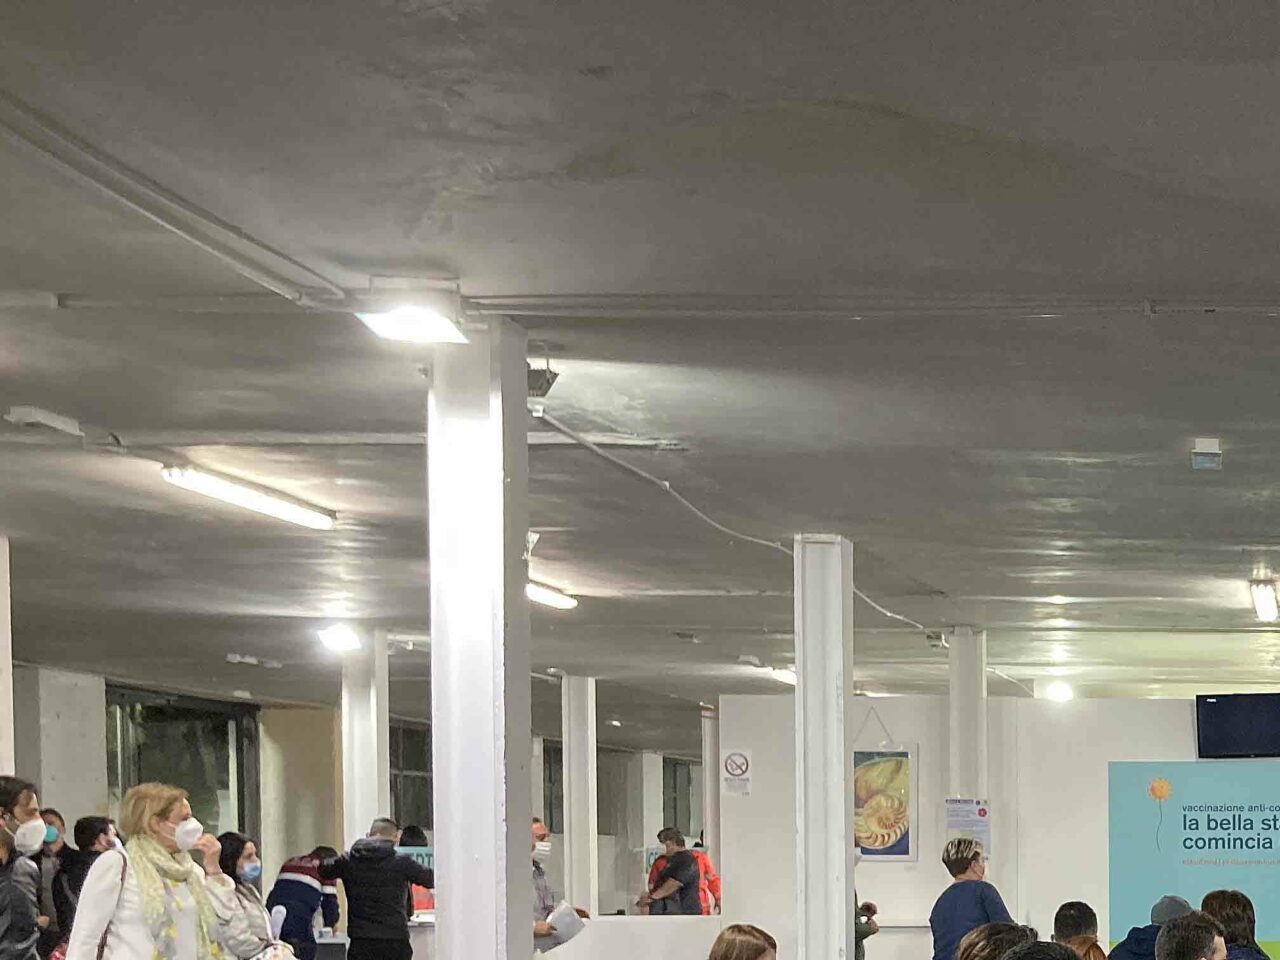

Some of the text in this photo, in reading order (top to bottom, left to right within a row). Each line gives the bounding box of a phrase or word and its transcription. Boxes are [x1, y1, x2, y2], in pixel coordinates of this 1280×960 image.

[1182, 804, 1245, 812] vaccinazione
[1183, 814, 1199, 831] la
[1207, 814, 1254, 831] bella
[1183, 833, 1273, 850] comincia
